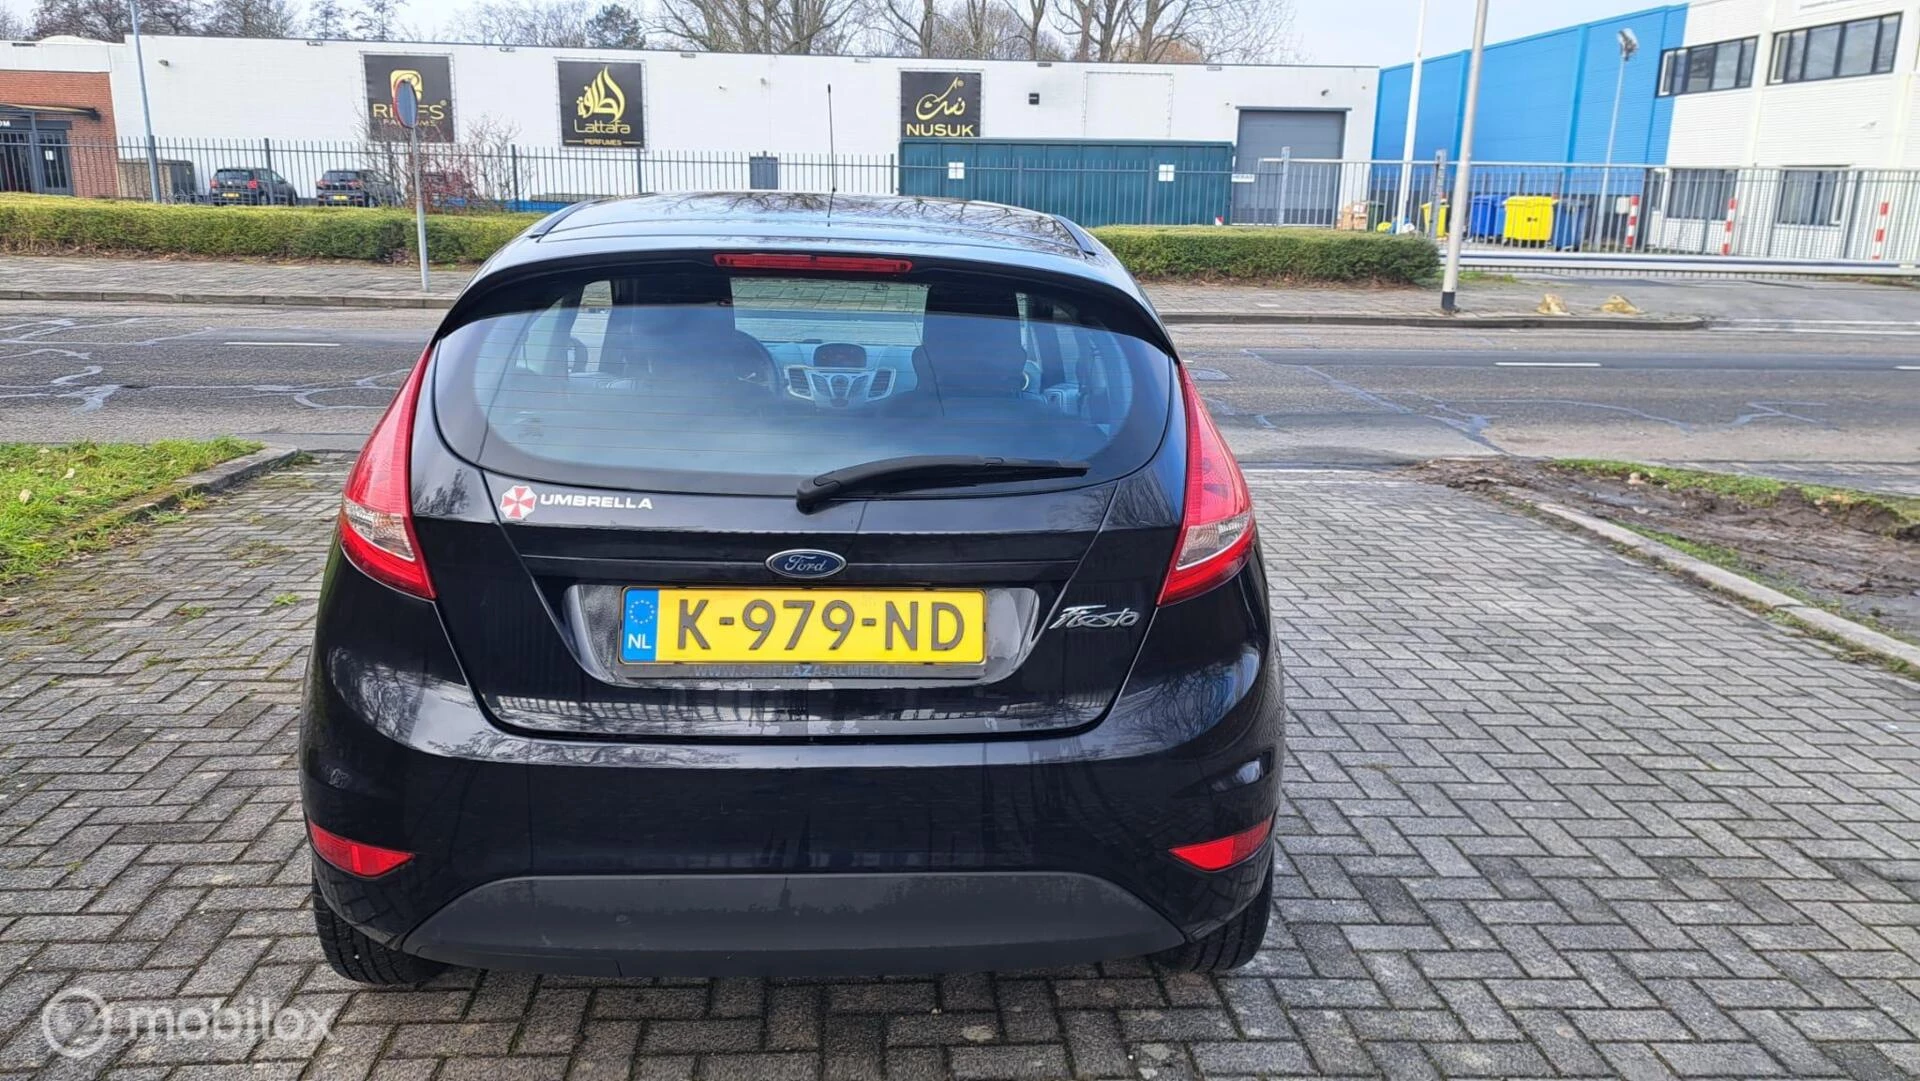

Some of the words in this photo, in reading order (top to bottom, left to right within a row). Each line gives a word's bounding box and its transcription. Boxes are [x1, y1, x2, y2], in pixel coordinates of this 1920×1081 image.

[574, 119, 631, 134] Lattafa
[906, 123, 974, 137] NUSUK
[584, 138, 622, 146] PERFUMES
[540, 494, 653, 510] UMBRELLA
[784, 554, 828, 571] Ford
[677, 599, 965, 651] K-979-ND
[1049, 604, 1140, 630] Fiesta
[628, 633, 651, 649] NL
